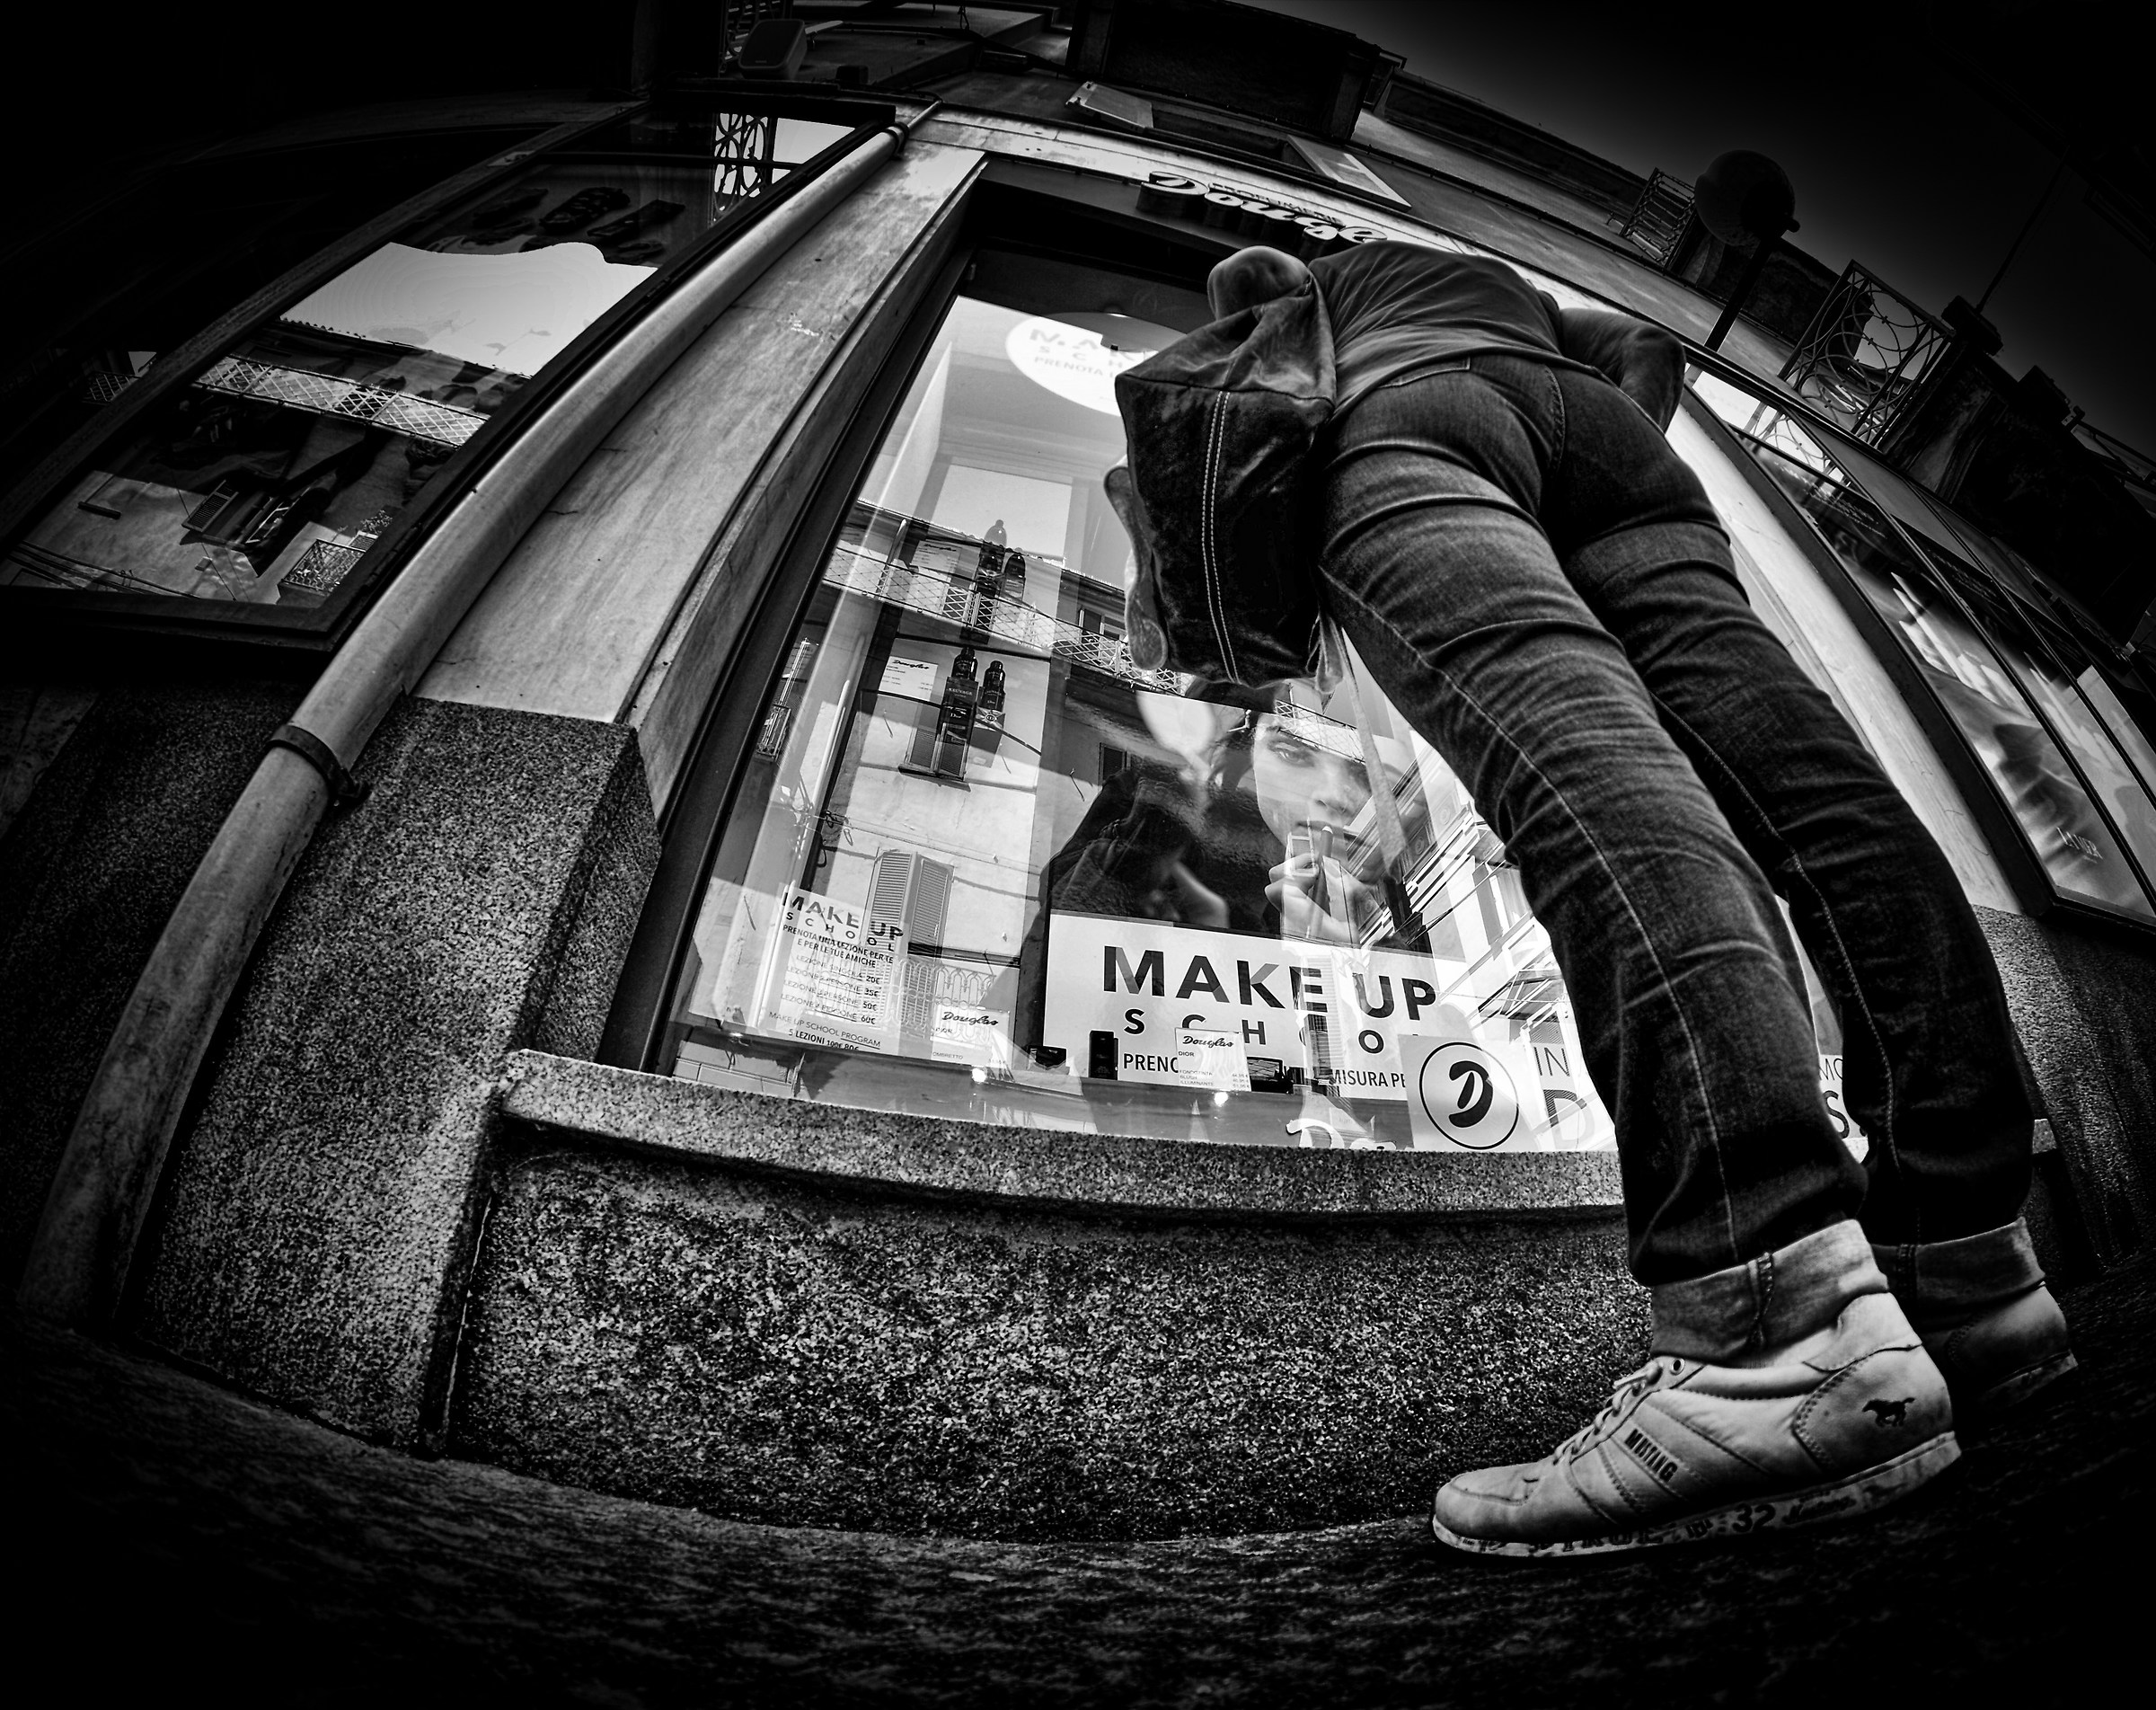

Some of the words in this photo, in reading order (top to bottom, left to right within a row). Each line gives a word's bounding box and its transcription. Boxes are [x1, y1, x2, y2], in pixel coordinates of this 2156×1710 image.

[1033, 356, 1104, 377] PRENOTA
[782, 892, 860, 929] MAKE
[870, 921, 904, 941] UP
[782, 924, 817, 941] PRENOTA
[818, 935, 835, 946] UNA
[836, 941, 868, 956] LEZIONE
[870, 951, 884, 960] PER
[885, 954, 894, 963] TE
[785, 911, 895, 952] SCHOOL
[804, 940, 819, 951] PER
[829, 948, 844, 959] TUE
[844, 952, 877, 969] AMICHE
[865, 975, 881, 985] 20€
[1103, 945, 1329, 1014] MAKE
[1351, 972, 1437, 1022] UP
[861, 1015, 876, 1025] 60€
[862, 1000, 878, 1011] 50€
[941, 1010, 999, 1026] Douglas
[768, 1011, 791, 1023] MAKE
[794, 1018, 805, 1026] UP
[806, 1022, 839, 1037] SCHOOL
[841, 1031, 880, 1048] PROGRAM
[788, 1028, 793, 1036] 5
[795, 1030, 826, 1044] LEZIONI
[1181, 1035, 1234, 1049] Douglas
[1624, 1428, 1678, 1483] MUSTANG
[1732, 1502, 1777, 1533] 32
